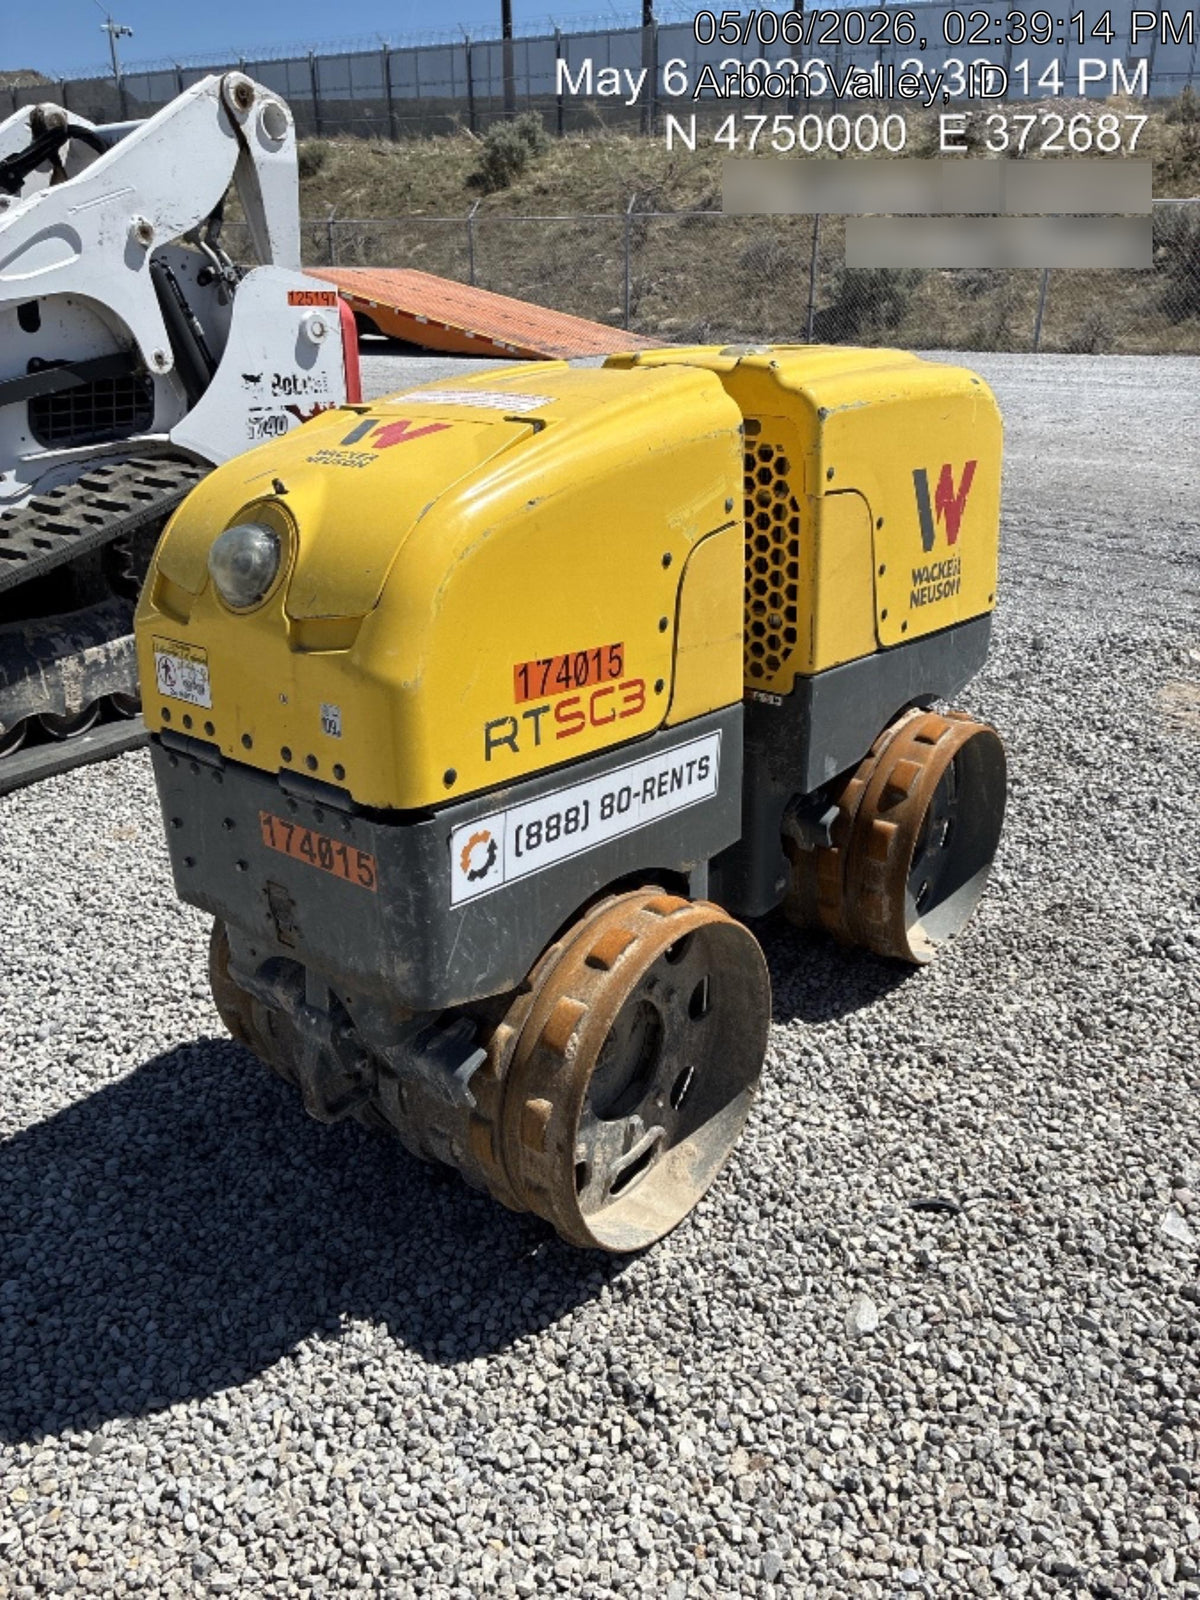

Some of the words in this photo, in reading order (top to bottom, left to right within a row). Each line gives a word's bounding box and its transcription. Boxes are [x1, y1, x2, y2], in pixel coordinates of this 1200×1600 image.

[909, 576, 961, 609] NEUSON
[517, 642, 625, 700] 174015
[513, 799, 591, 858] (888)
[599, 754, 711, 822] 80-RENTS
[260, 815, 376, 888] 174015
